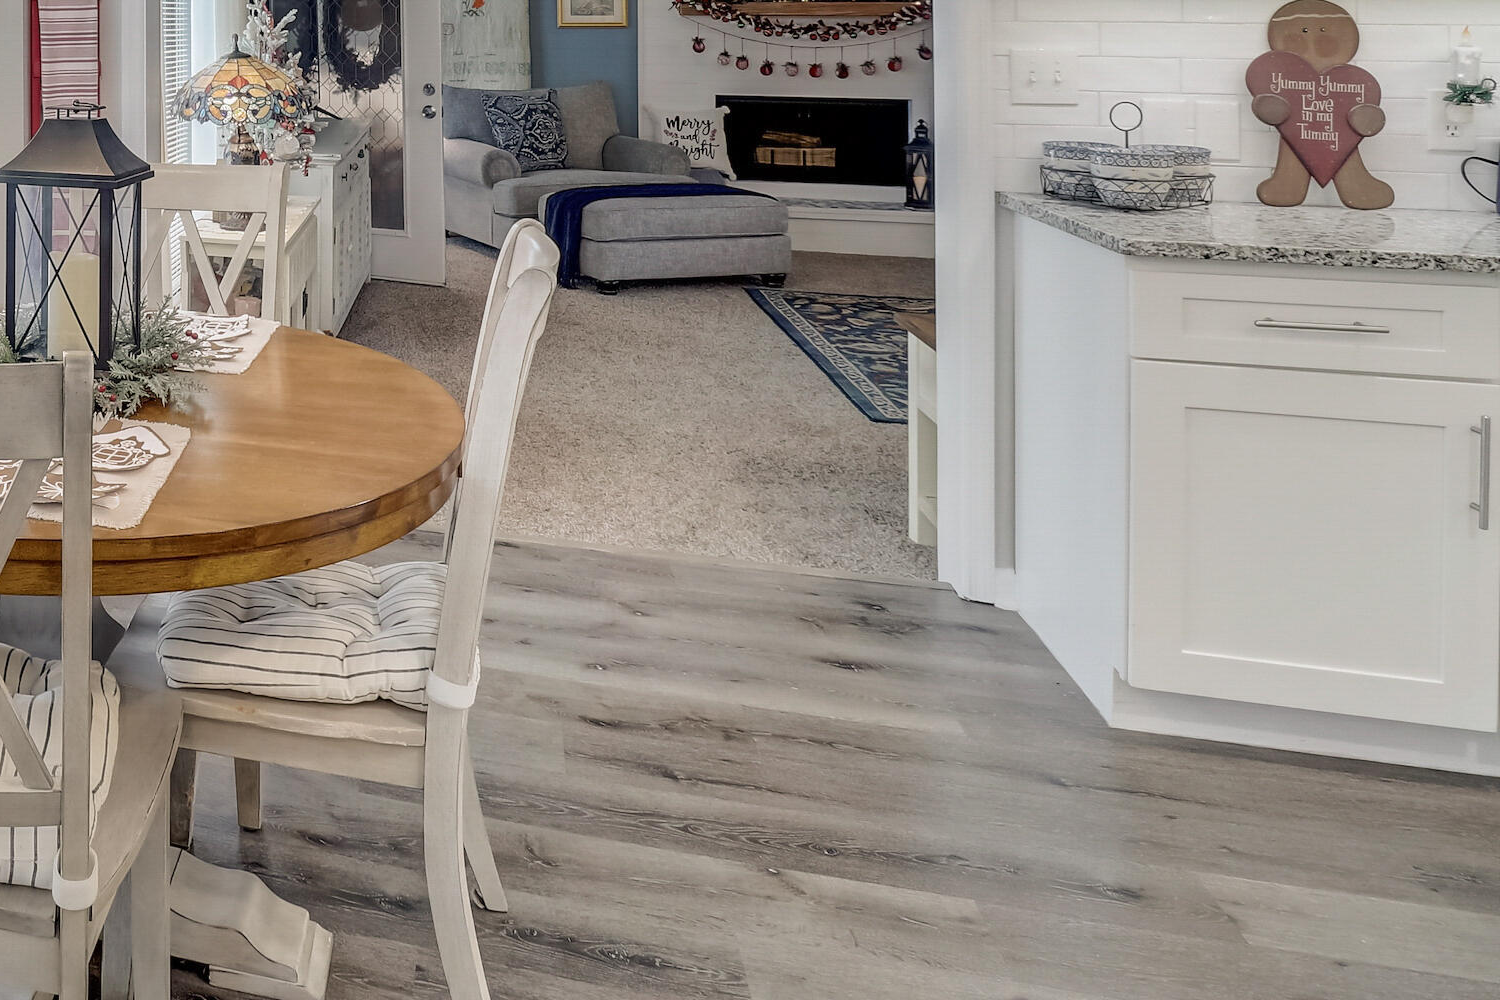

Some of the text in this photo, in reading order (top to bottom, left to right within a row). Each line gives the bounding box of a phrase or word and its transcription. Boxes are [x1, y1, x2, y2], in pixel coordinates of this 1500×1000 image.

[1270, 72, 1365, 103] Yummy Yummy
[1302, 95, 1334, 112] Love
[666, 116, 714, 136] Merry
[1302, 110, 1333, 131] in my
[680, 129, 700, 143] and
[1296, 123, 1339, 150] Tummy
